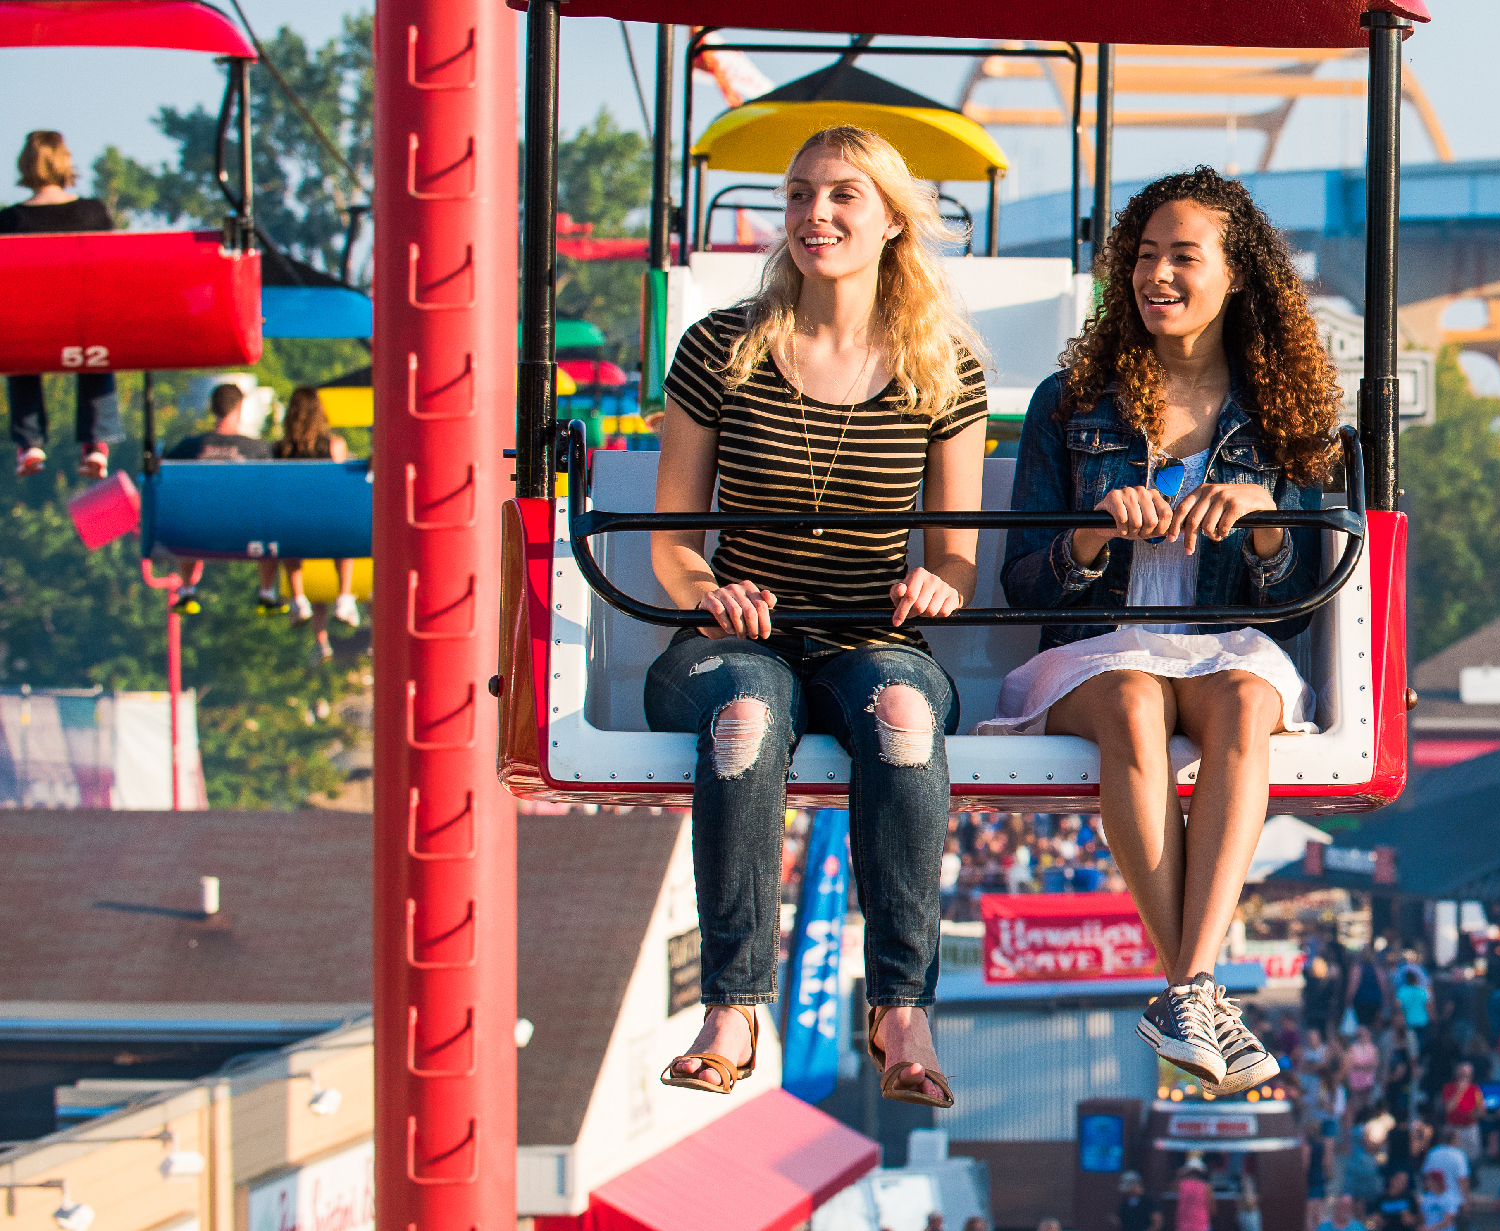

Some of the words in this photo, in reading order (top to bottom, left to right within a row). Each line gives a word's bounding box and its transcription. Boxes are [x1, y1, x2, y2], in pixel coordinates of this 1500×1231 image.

[61, 345, 110, 367] 52
[998, 918, 1143, 955] Hawaiian
[797, 918, 842, 1040] ATM
